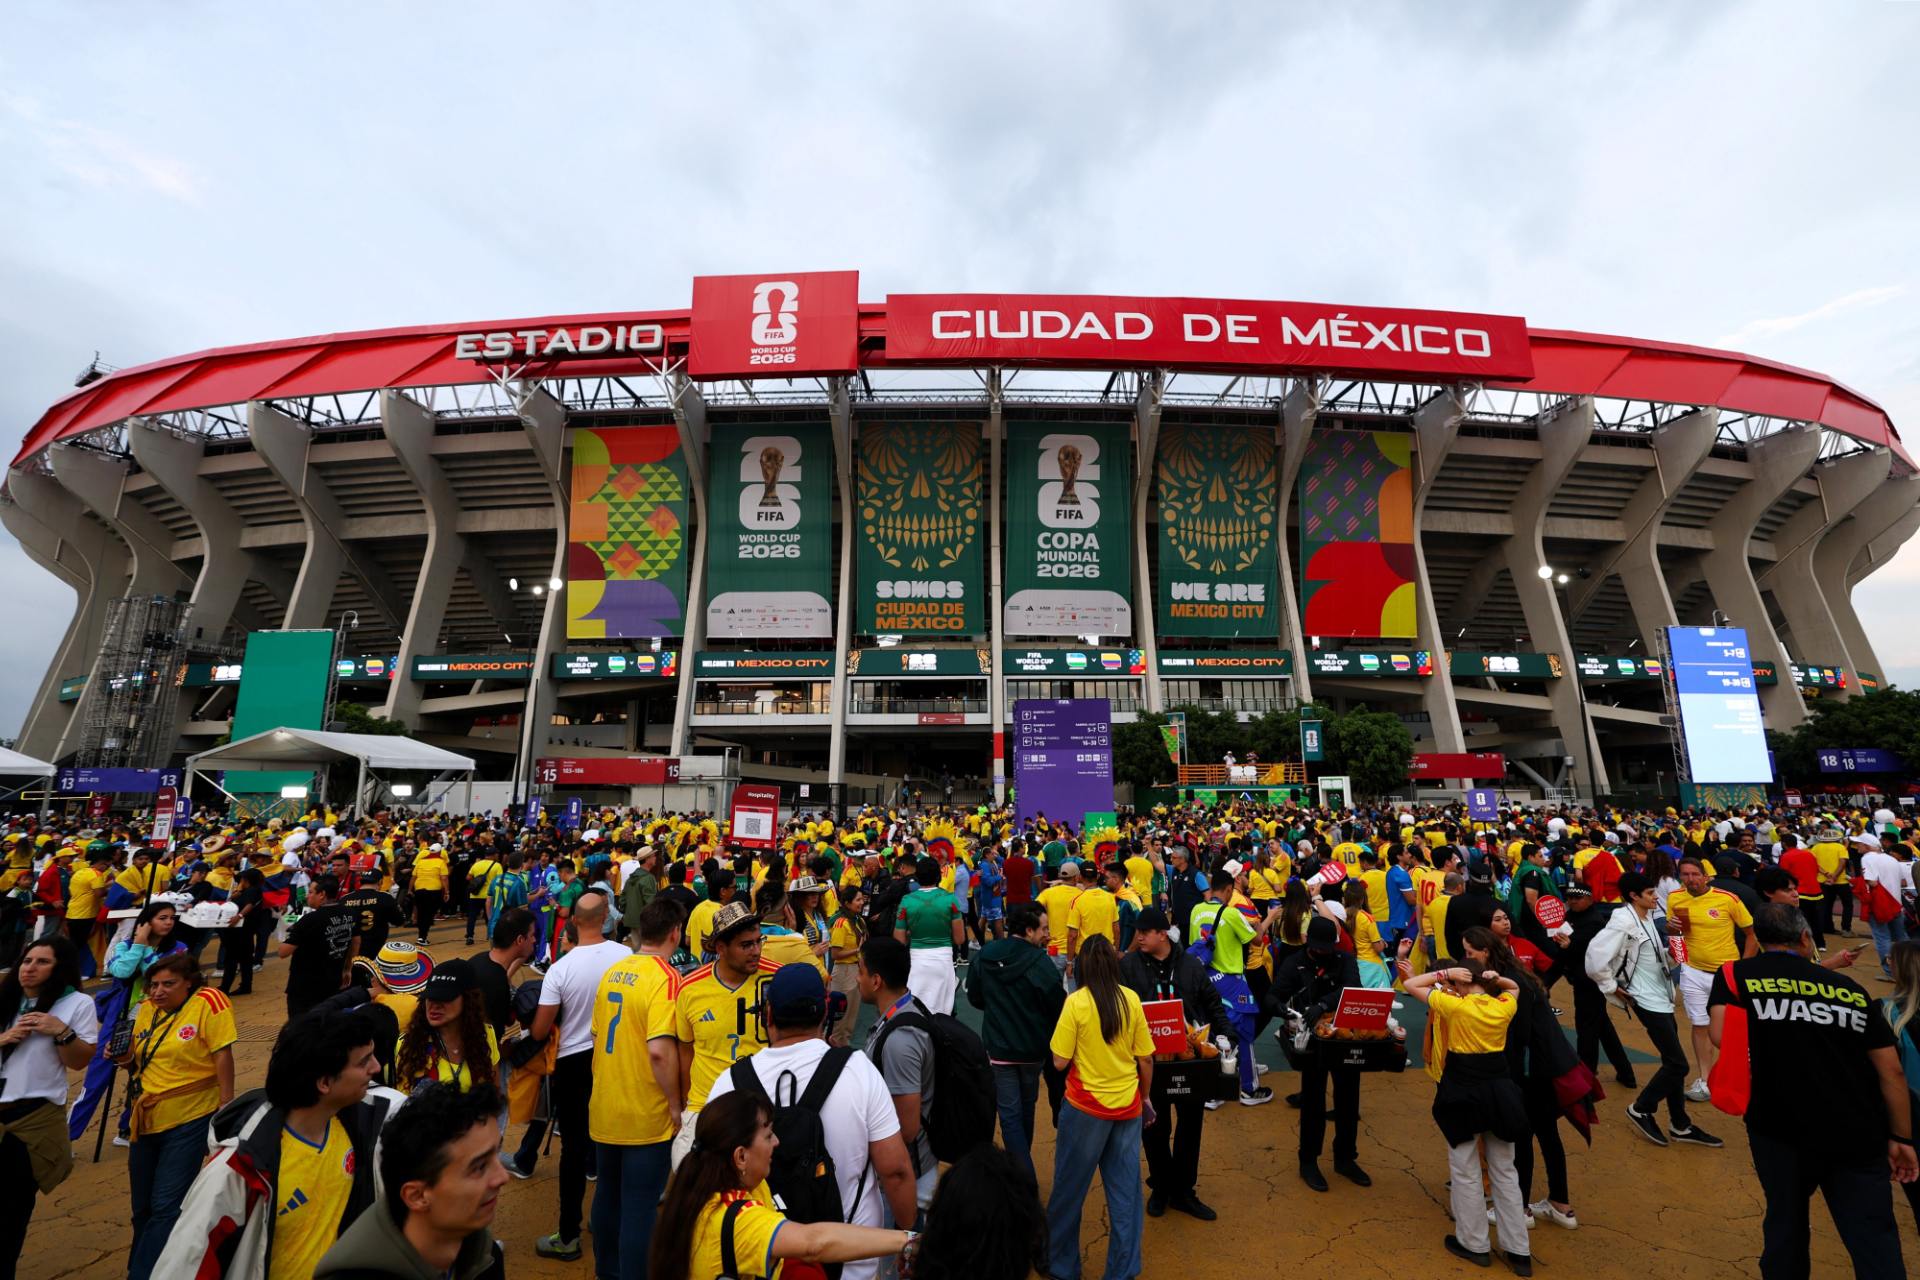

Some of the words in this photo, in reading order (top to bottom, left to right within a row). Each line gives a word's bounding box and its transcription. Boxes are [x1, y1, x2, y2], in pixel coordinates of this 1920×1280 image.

[764, 331, 785, 339] FIFA
[932, 310, 1154, 340] CIUDAD
[1183, 313, 1260, 344] DE
[1281, 313, 1492, 358] MÉXICO
[455, 324, 664, 359] ESTADIO
[750, 354, 797, 365] 2026
[756, 511, 785, 521] FIFA
[1055, 509, 1084, 520] FIFA
[739, 534, 778, 543] WORLD
[779, 534, 801, 543] CUP
[1037, 532, 1100, 550] COPA
[738, 544, 801, 558] 2026
[1037, 551, 1100, 562] MUNDIAL
[1037, 563, 1100, 578] 2026
[876, 580, 964, 598] SOMOS
[1171, 582, 1210, 601] WE
[1214, 583, 1265, 602] ARE
[875, 602, 940, 615] CIUDAD
[942, 602, 964, 615] DE
[1170, 603, 1229, 618] MEXICO
[1232, 604, 1265, 618] CITY
[875, 614, 965, 630] MÉXICO
[449, 663, 501, 671] MEXICO
[502, 662, 534, 670] CITY
[736, 659, 793, 668] MEXICO
[795, 659, 829, 667] CITY
[1196, 658, 1250, 666] MEXICO
[1252, 658, 1285, 666] CITY
[1752, 668, 1772, 676] CITY
[1821, 755, 1838, 766] 18
[1842, 758, 1855, 770] 18
[543, 768, 557, 782] 15
[667, 765, 679, 777] 15
[61, 777, 75, 790] 13
[161, 774, 177, 786] 13
[1343, 851, 1356, 864] 10
[1420, 879, 1436, 906] 10
[362, 898, 377, 906] LUIS
[361, 910, 374, 931] 3
[608, 971, 622, 983] LUIS
[1744, 977, 1868, 1008] RESIDUOS
[1343, 1006, 1378, 1016] $240
[1751, 998, 1868, 1034] WASTE
[605, 991, 623, 1054] 7
[727, 1033, 740, 1060] 7
